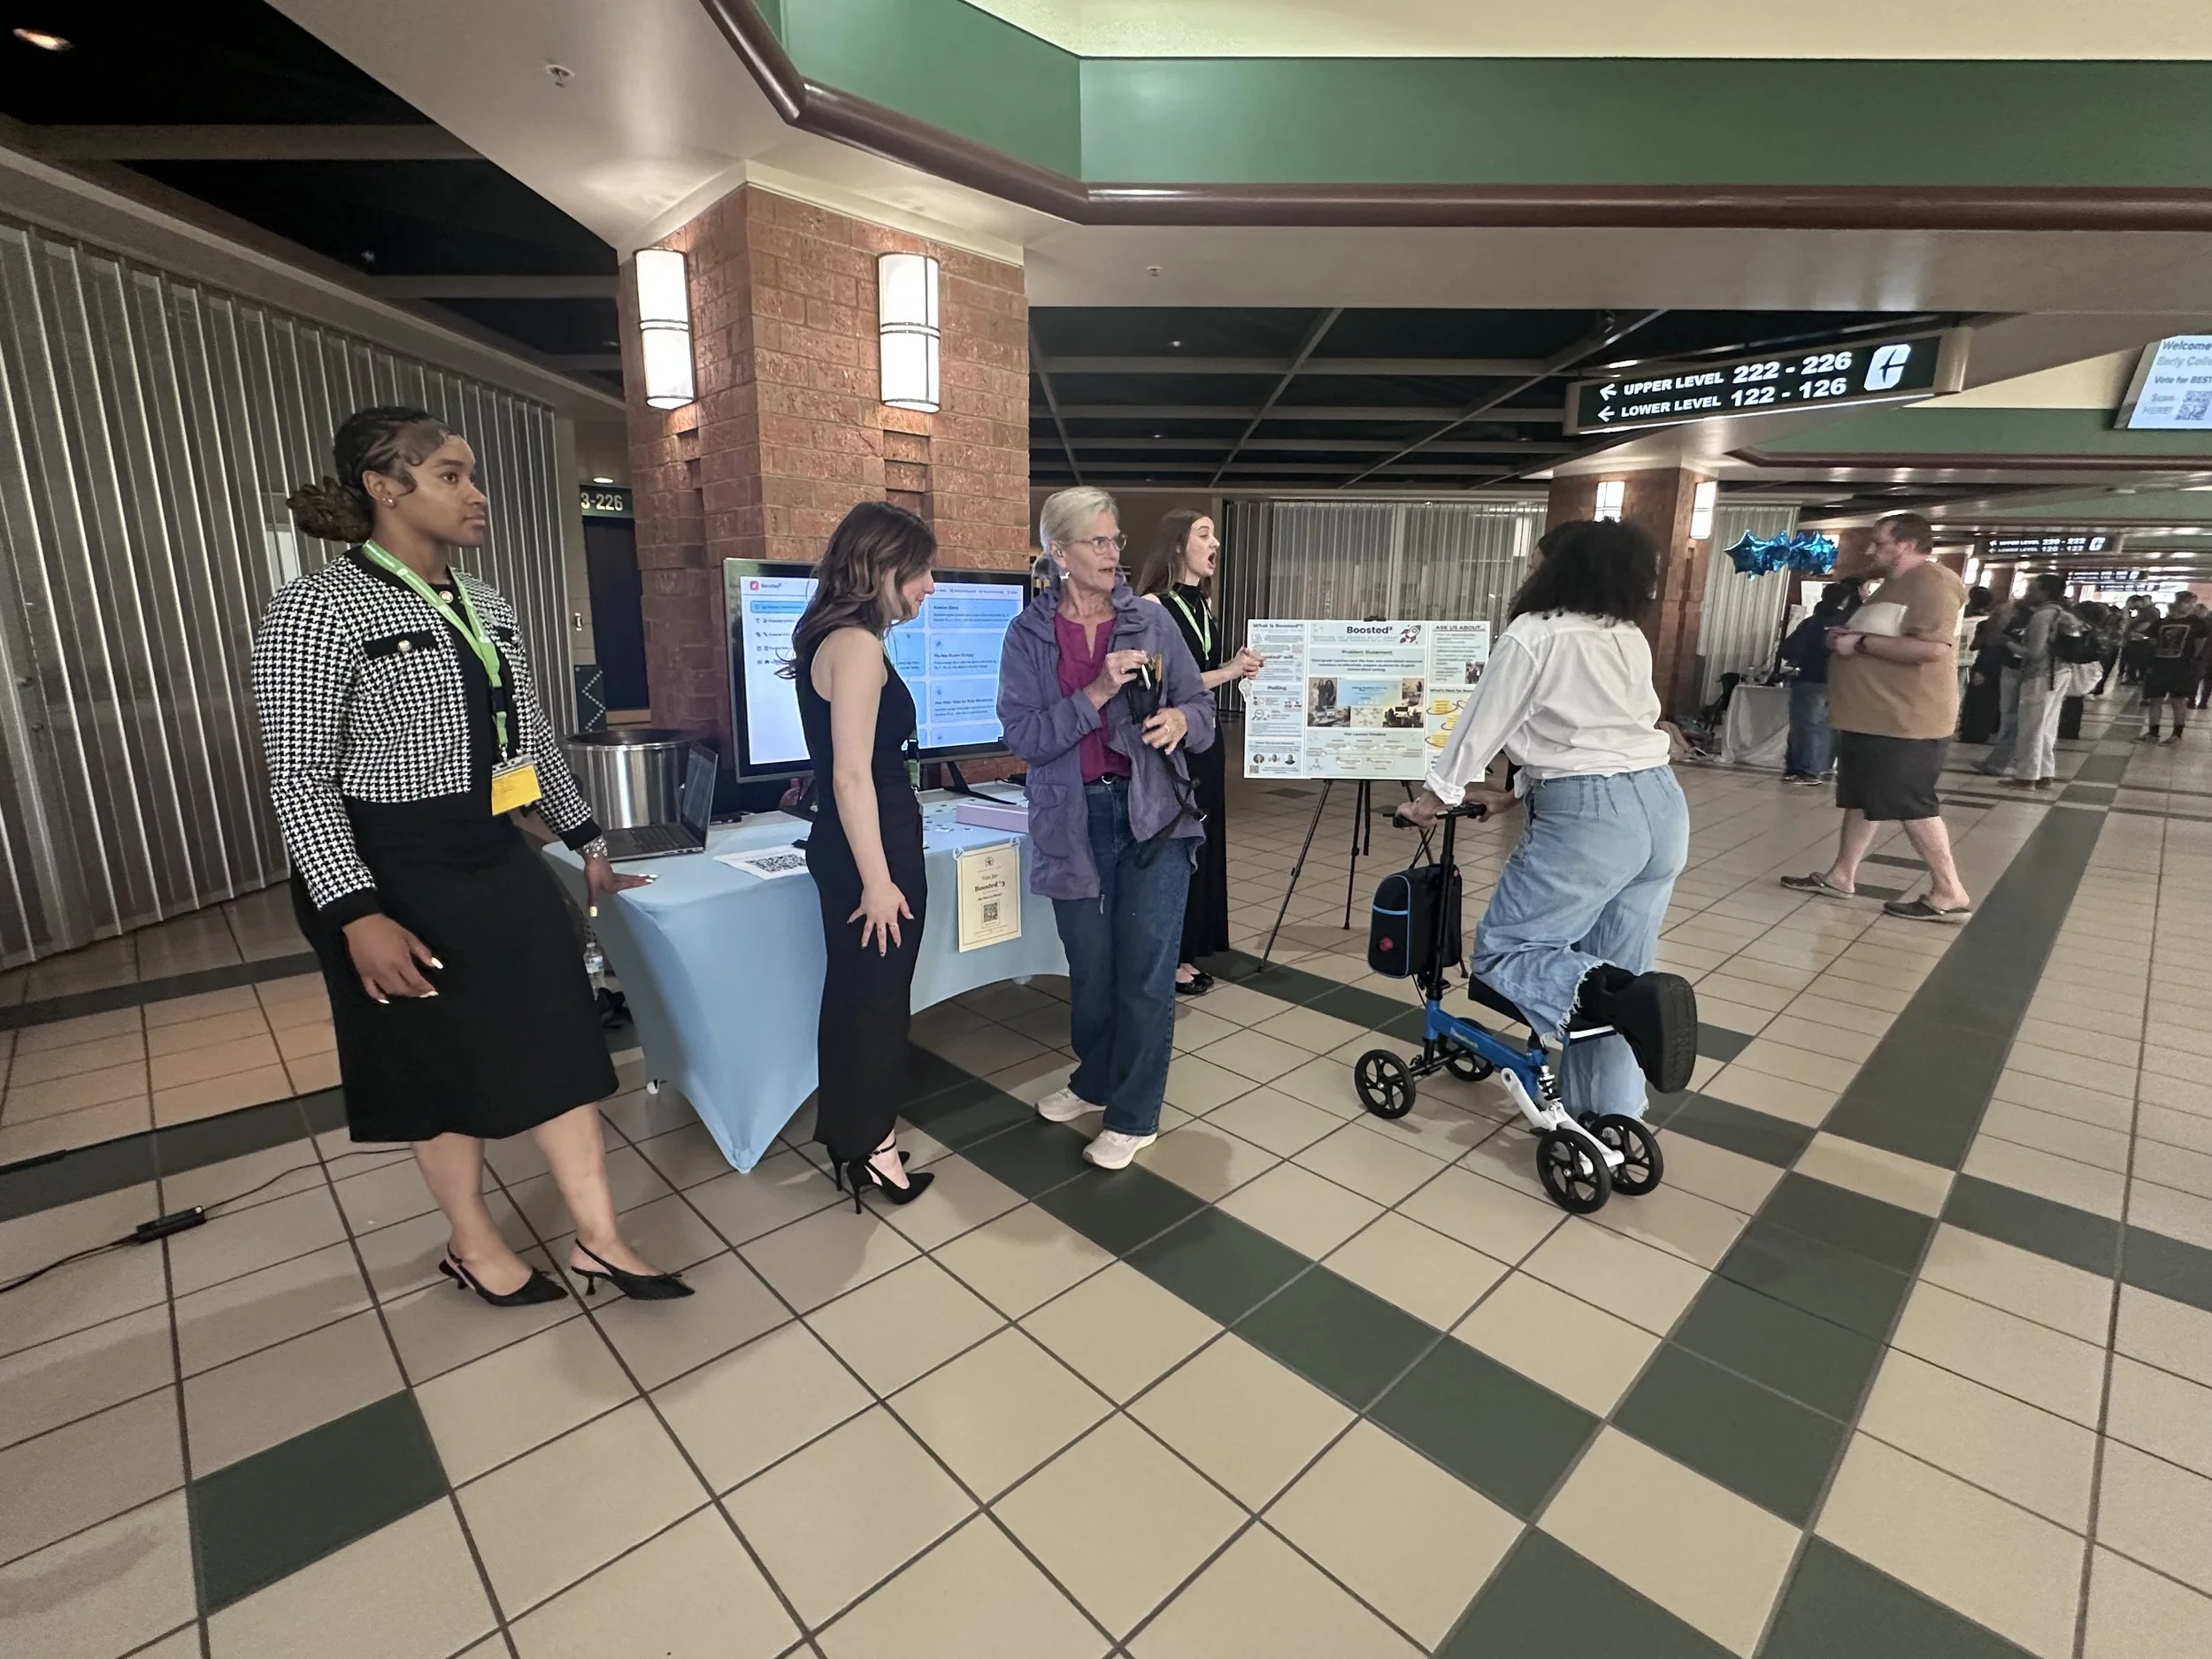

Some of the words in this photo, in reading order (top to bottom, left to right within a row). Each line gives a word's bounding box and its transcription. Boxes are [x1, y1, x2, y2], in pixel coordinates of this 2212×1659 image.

[2162, 341, 2212, 351] Welcome
[1624, 379, 1672, 396] UPPER
[1675, 373, 1724, 389] LEVEL
[1732, 361, 1781, 384] 222
[1801, 351, 1853, 375] 226
[1621, 402, 1671, 418] LOWER
[1674, 396, 1722, 411] LEVEL
[1731, 386, 1776, 407] 122
[1799, 378, 1847, 399] 126
[1347, 626, 1393, 634] Boosted²
